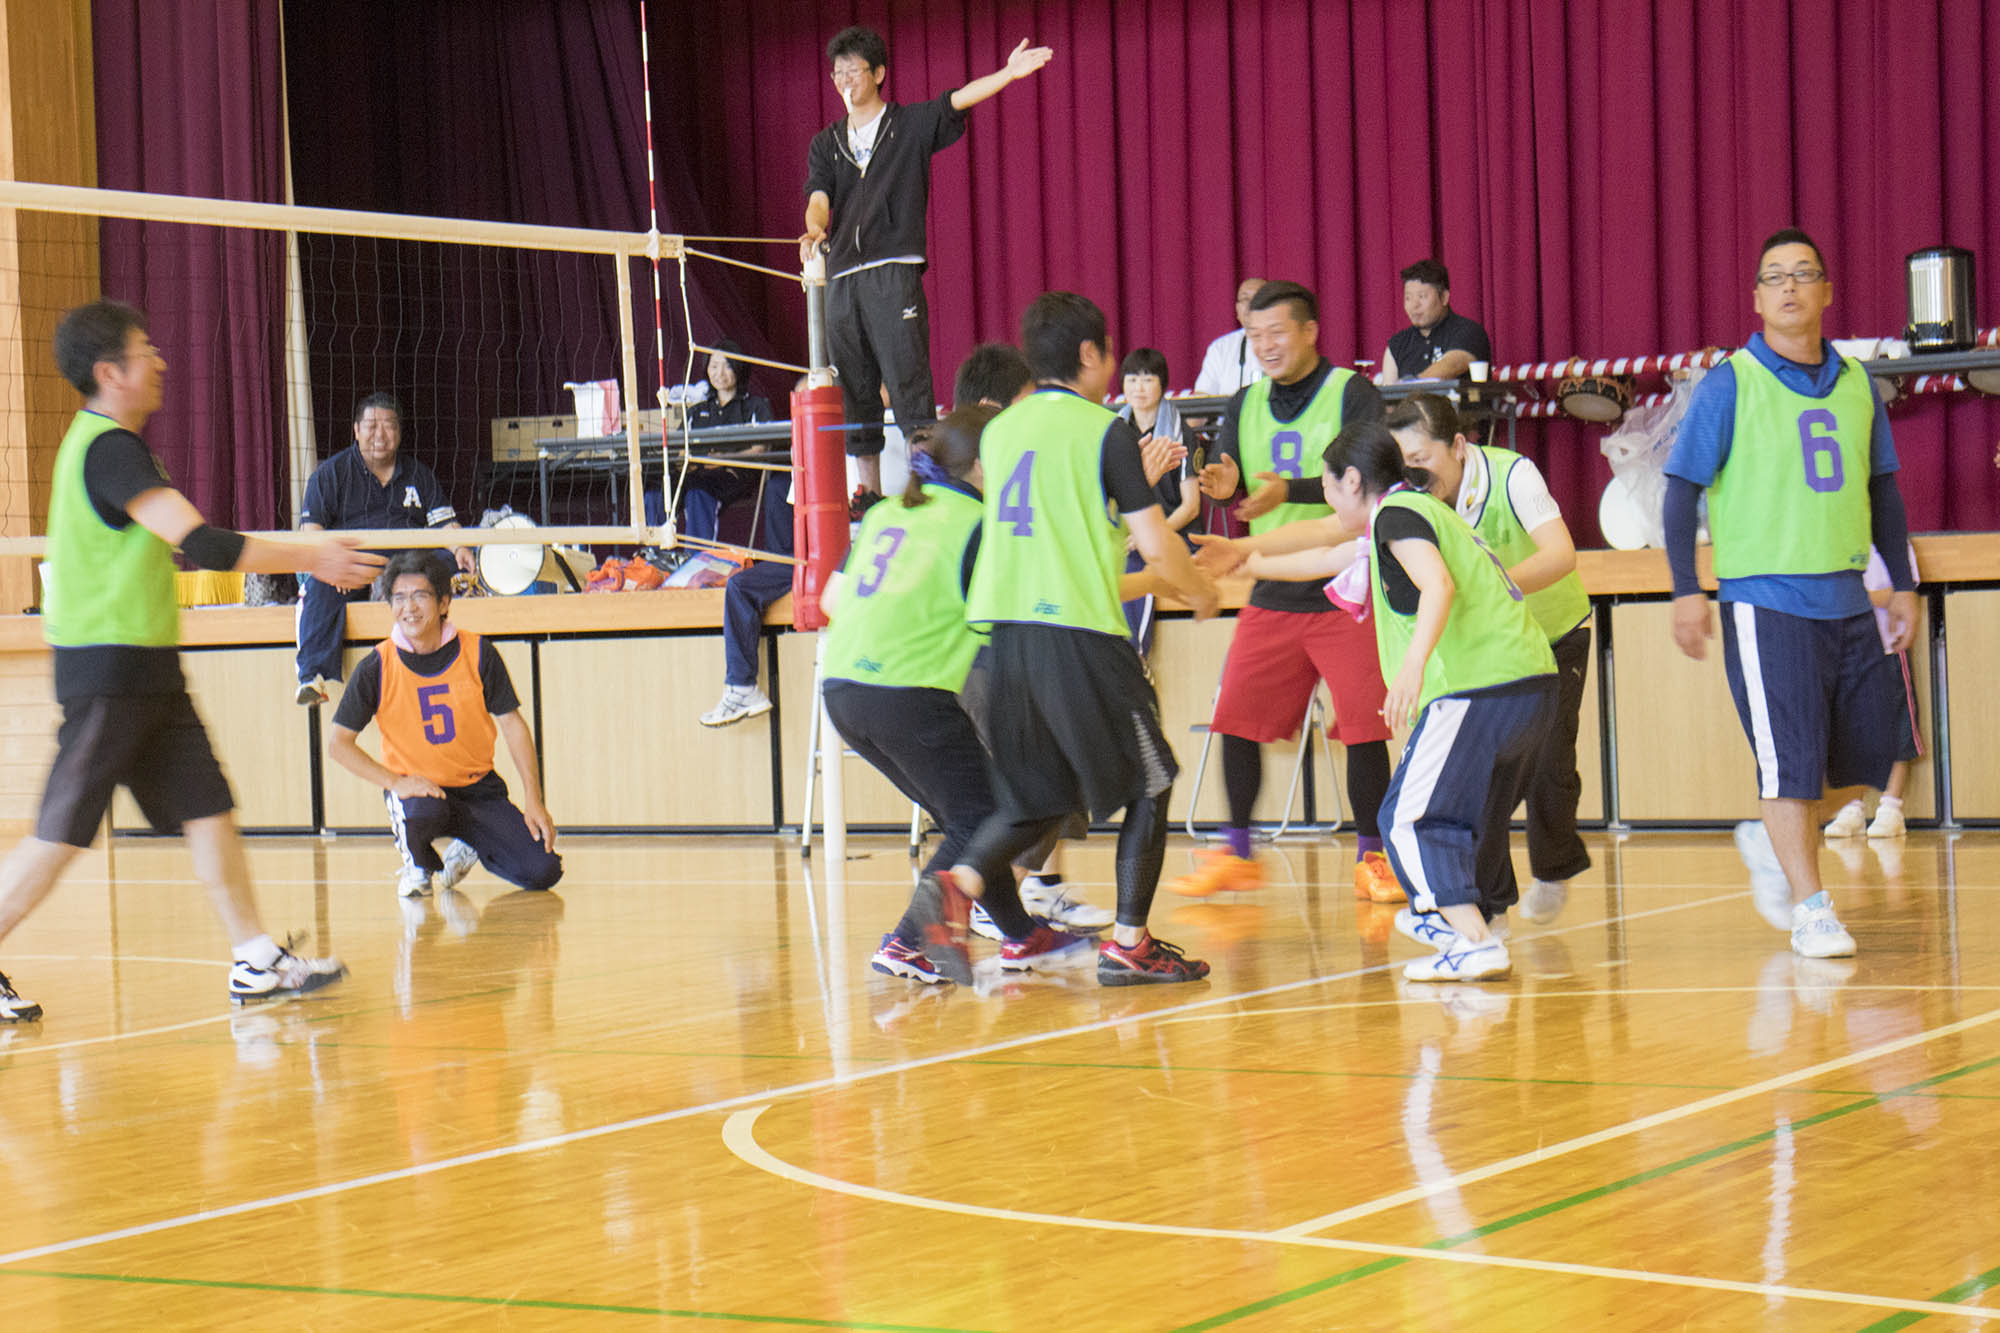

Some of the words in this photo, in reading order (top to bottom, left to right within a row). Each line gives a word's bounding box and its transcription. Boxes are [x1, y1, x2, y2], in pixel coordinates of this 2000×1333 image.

[1798, 408, 1844, 493] 6
[403, 486, 422, 508] A
[998, 450, 1035, 537] 4
[857, 527, 906, 598] 3
[417, 683, 456, 744] 5
